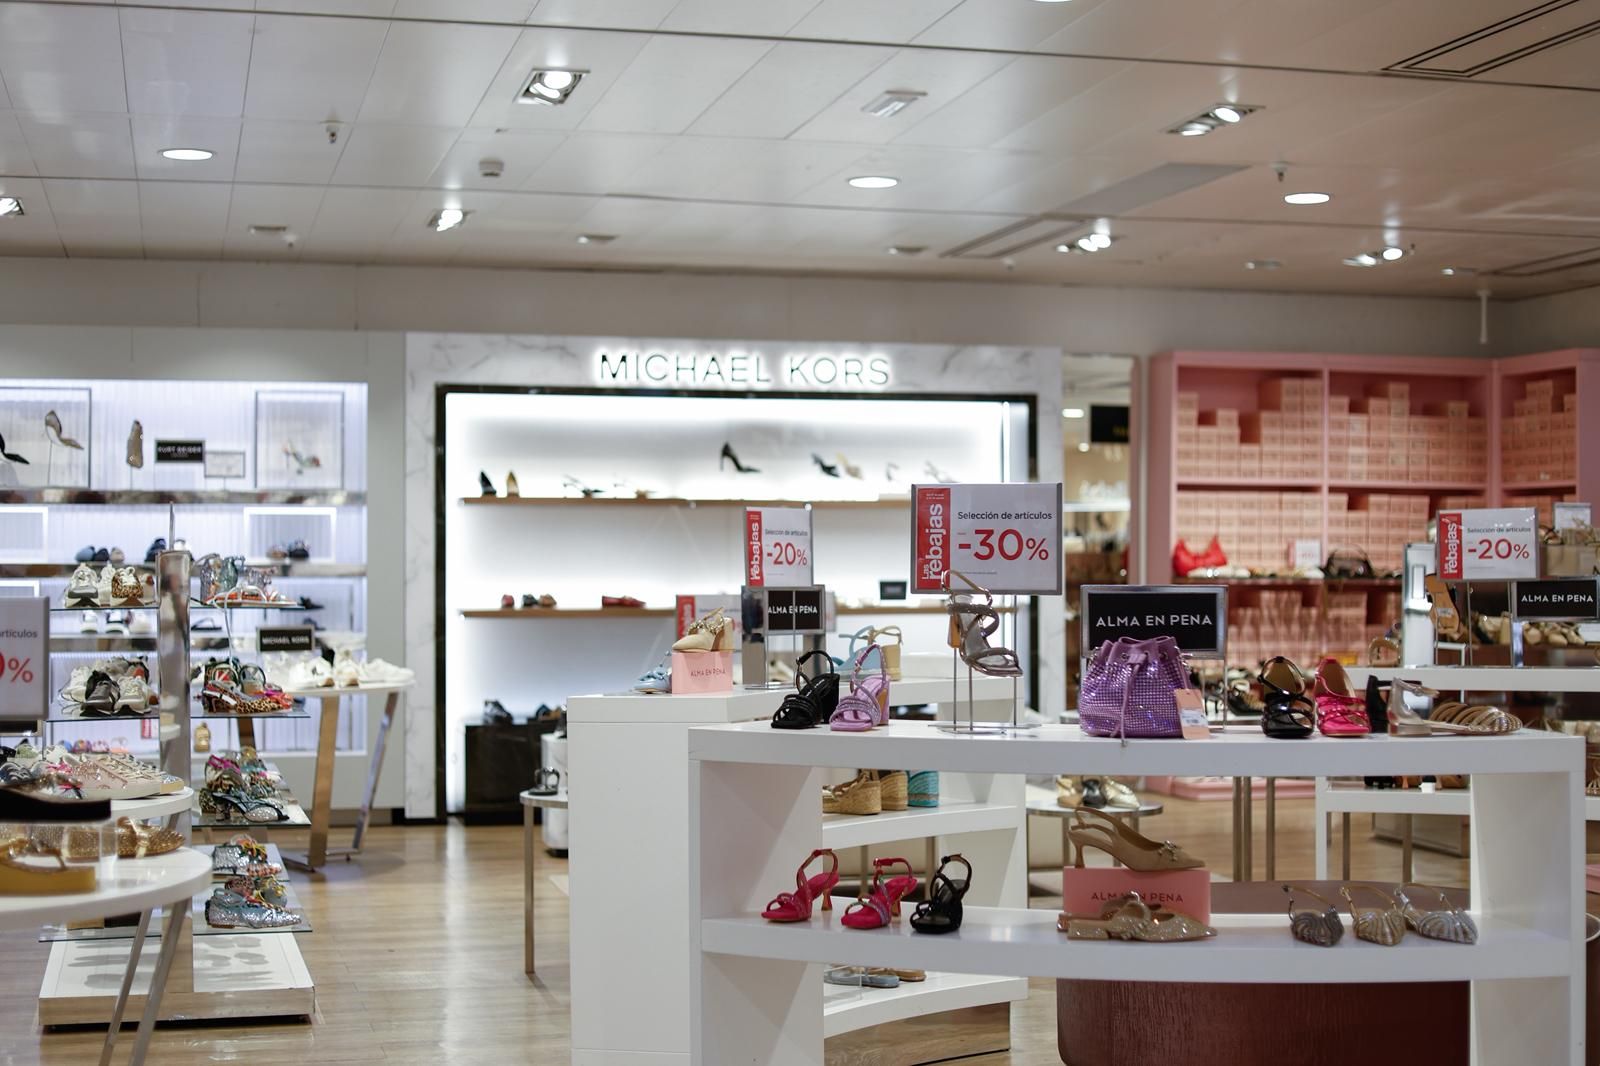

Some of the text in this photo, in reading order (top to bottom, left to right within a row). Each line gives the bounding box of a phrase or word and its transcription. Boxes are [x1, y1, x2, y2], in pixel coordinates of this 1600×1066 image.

[600, 354, 889, 385] MICHAEL KORS
[957, 511, 1053, 520] Selección de artículos
[925, 503, 946, 580] rebajas
[958, 528, 1049, 561] -30%
[1445, 522, 1460, 574] rebajas
[1467, 538, 1530, 560] -20%
[750, 522, 761, 580] rebajas
[766, 541, 808, 566] -20%
[1521, 594, 1594, 602] ALMA EN PENA
[767, 605, 788, 614] ALMA
[799, 605, 818, 614] PENA
[1096, 614, 1213, 627] ALMA EN PENA
[0, 629, 38, 638] rtículos
[690, 669, 704, 677] ALMA
[705, 668, 712, 677] EN
[1091, 892, 1126, 901] ALM
[1150, 892, 1184, 903] PENA
